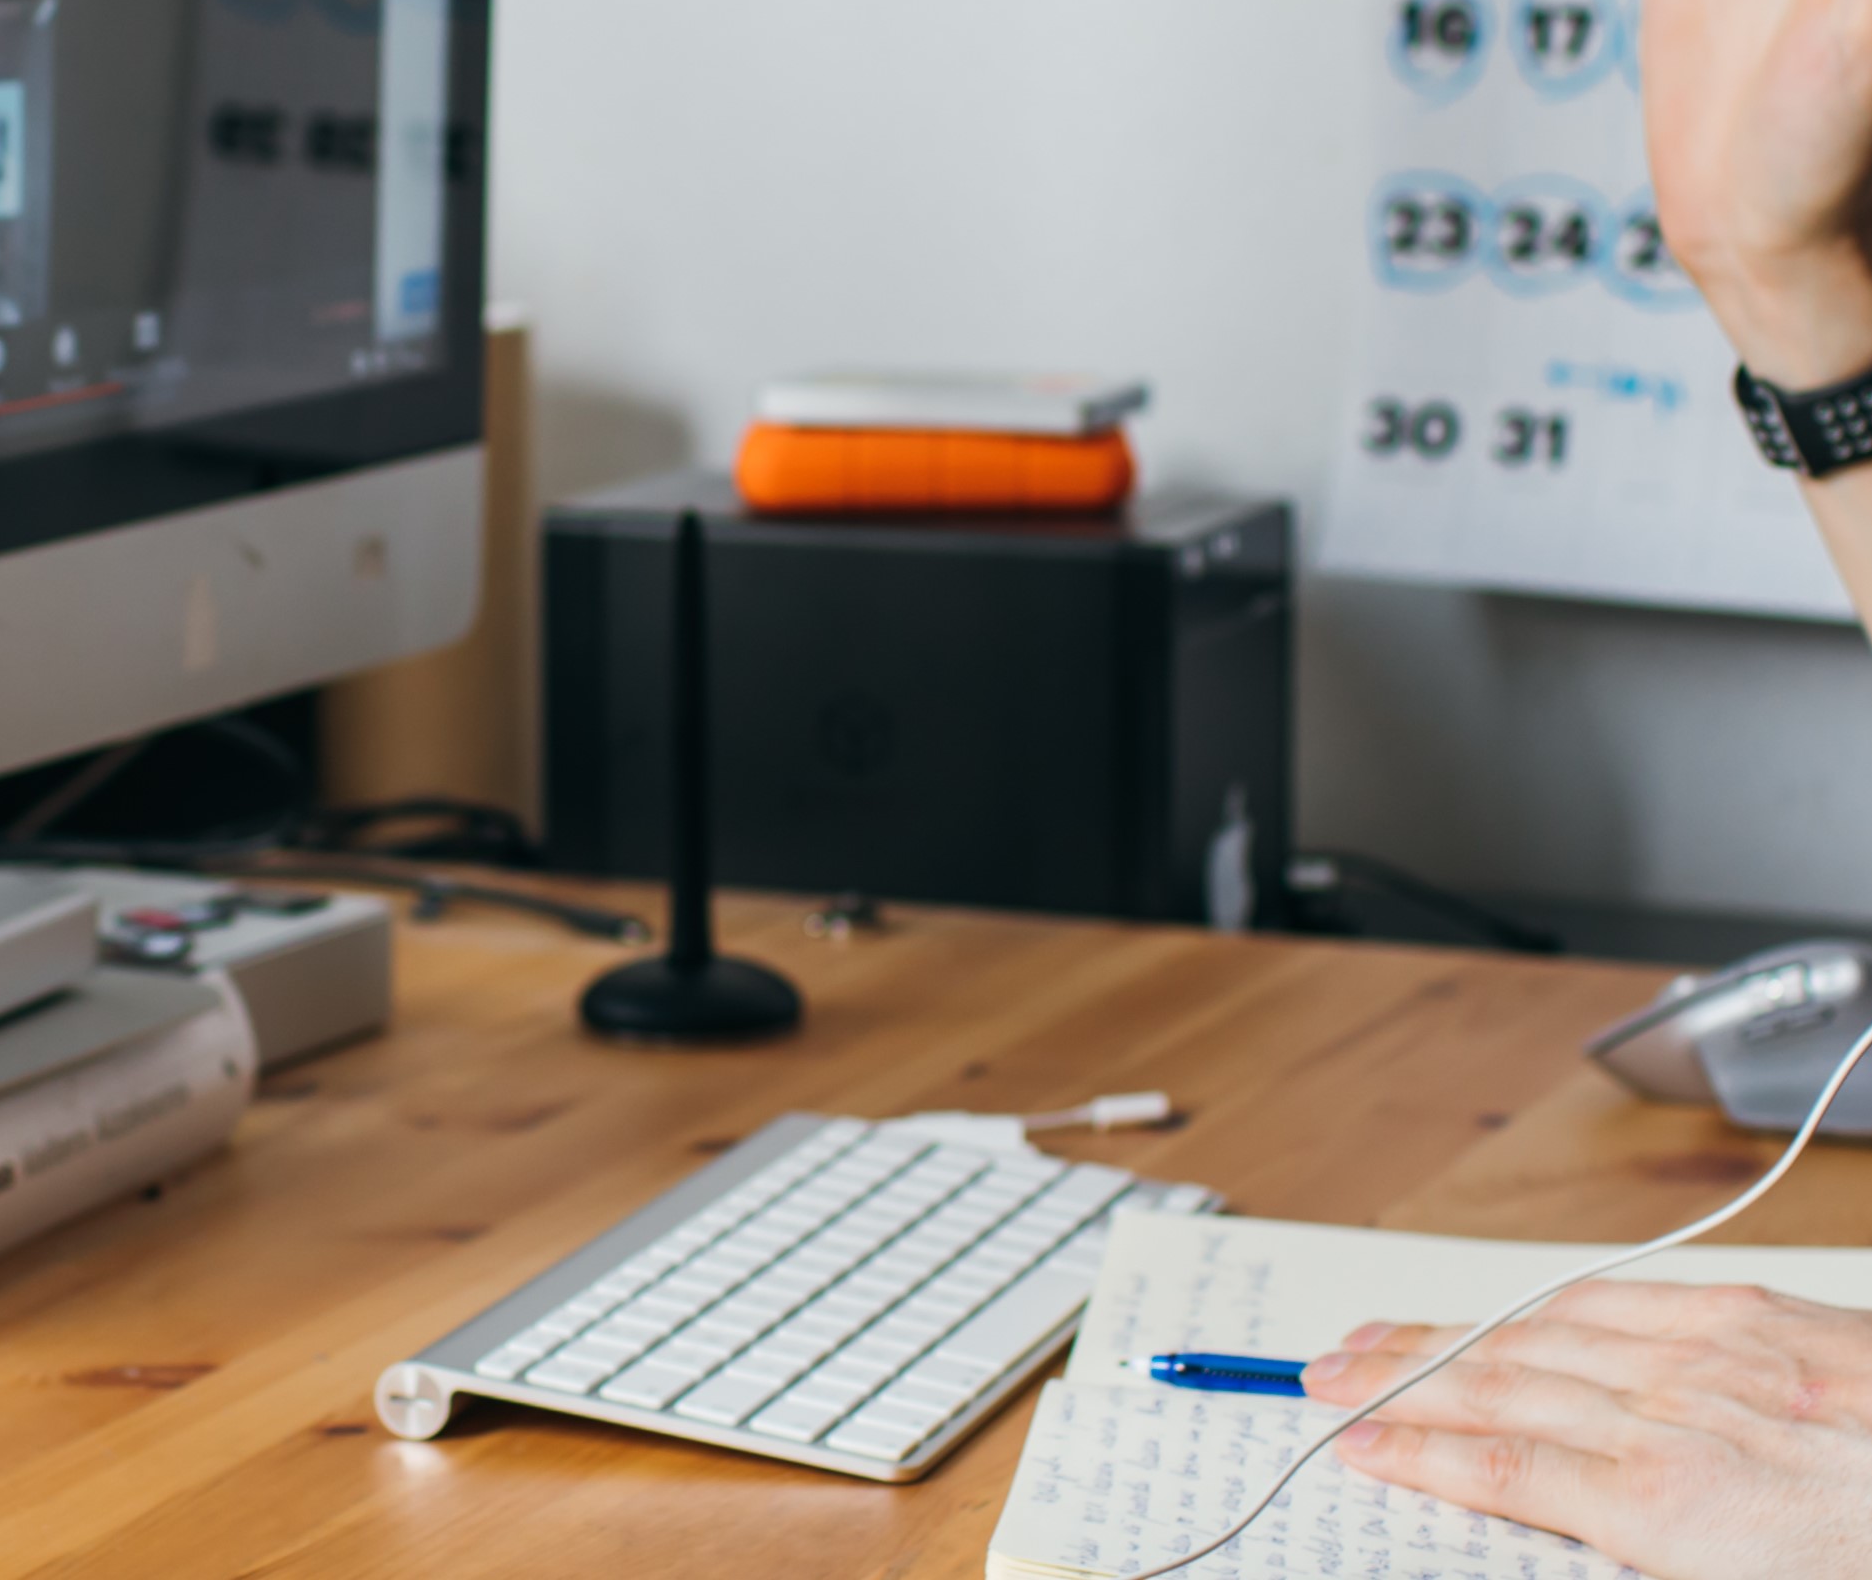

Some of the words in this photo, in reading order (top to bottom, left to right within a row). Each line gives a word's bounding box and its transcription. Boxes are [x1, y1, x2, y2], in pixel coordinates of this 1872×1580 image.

[1379, 189, 1484, 265] 23
[1491, 201, 1605, 270] 24
[1623, 210, 1667, 273] 2
[1363, 395, 1466, 463] 30
[1491, 406, 1573, 469] 31
